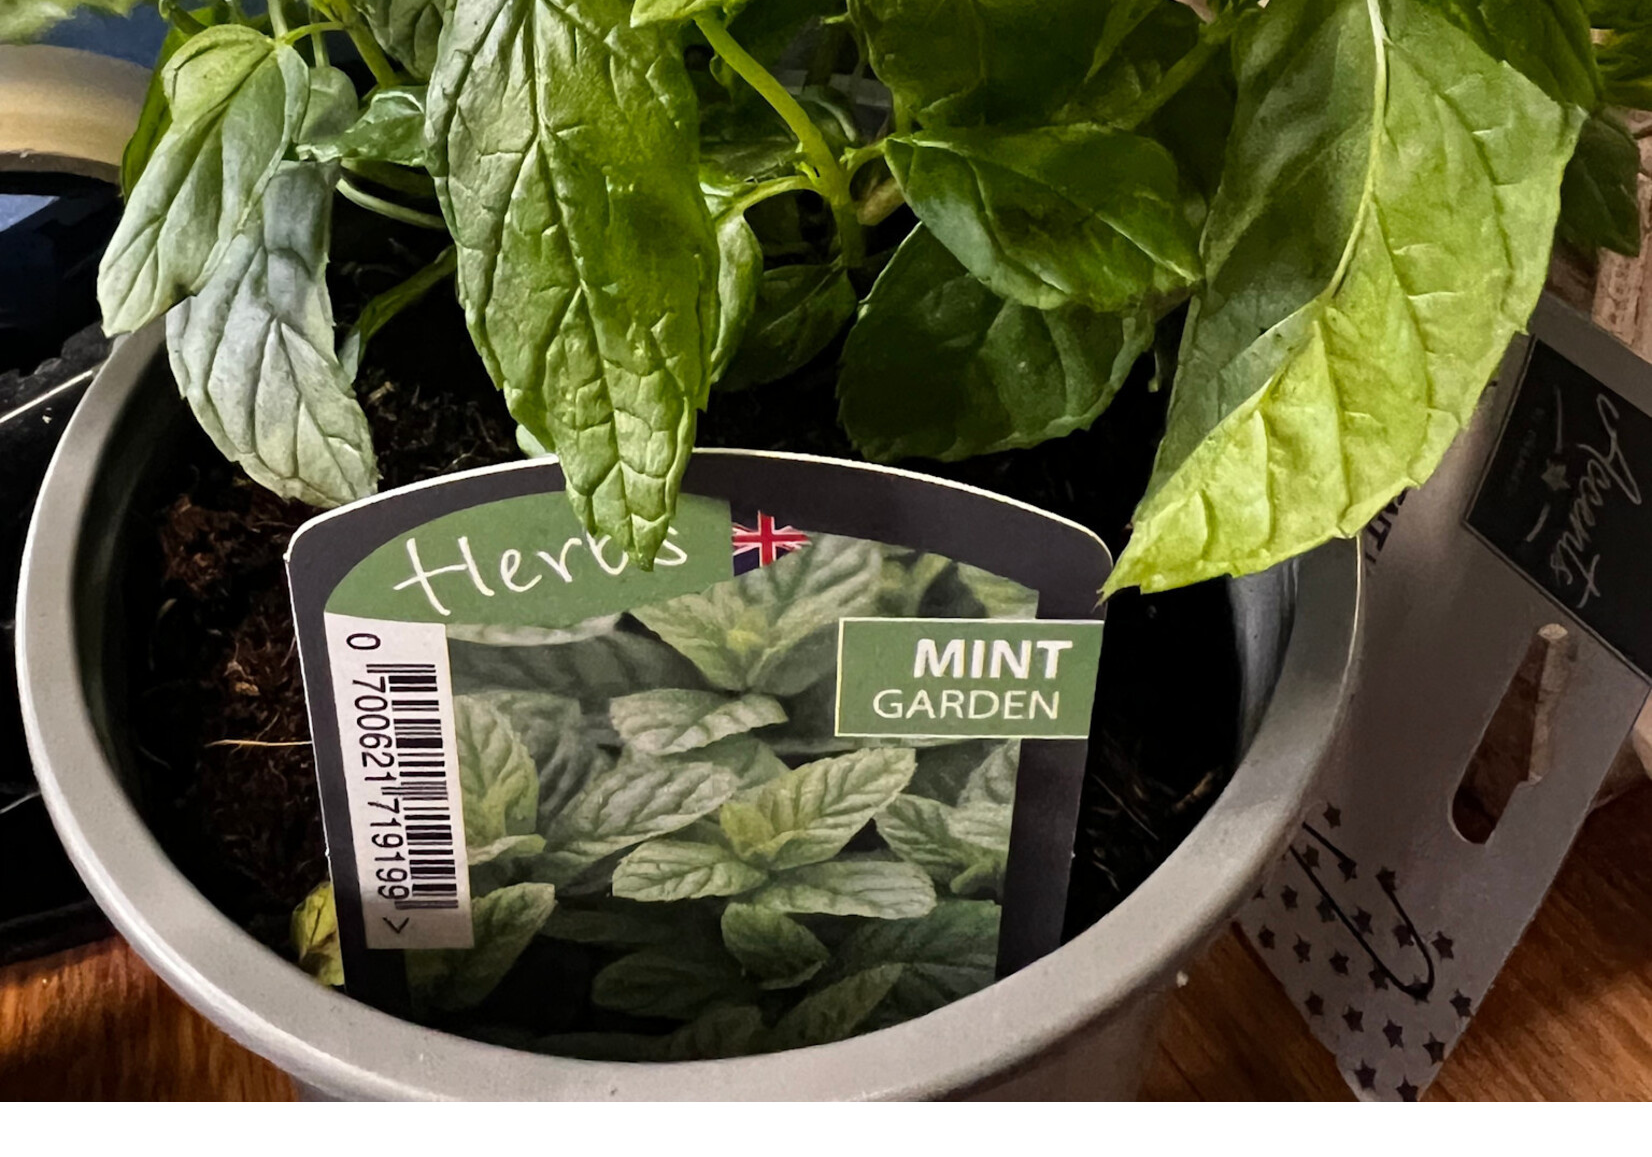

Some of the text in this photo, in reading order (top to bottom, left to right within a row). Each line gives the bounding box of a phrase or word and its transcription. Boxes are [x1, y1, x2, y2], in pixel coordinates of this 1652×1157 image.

[345, 632, 382, 651] 0
[913, 638, 1074, 680] MINT
[872, 688, 1061, 720] GARDEN
